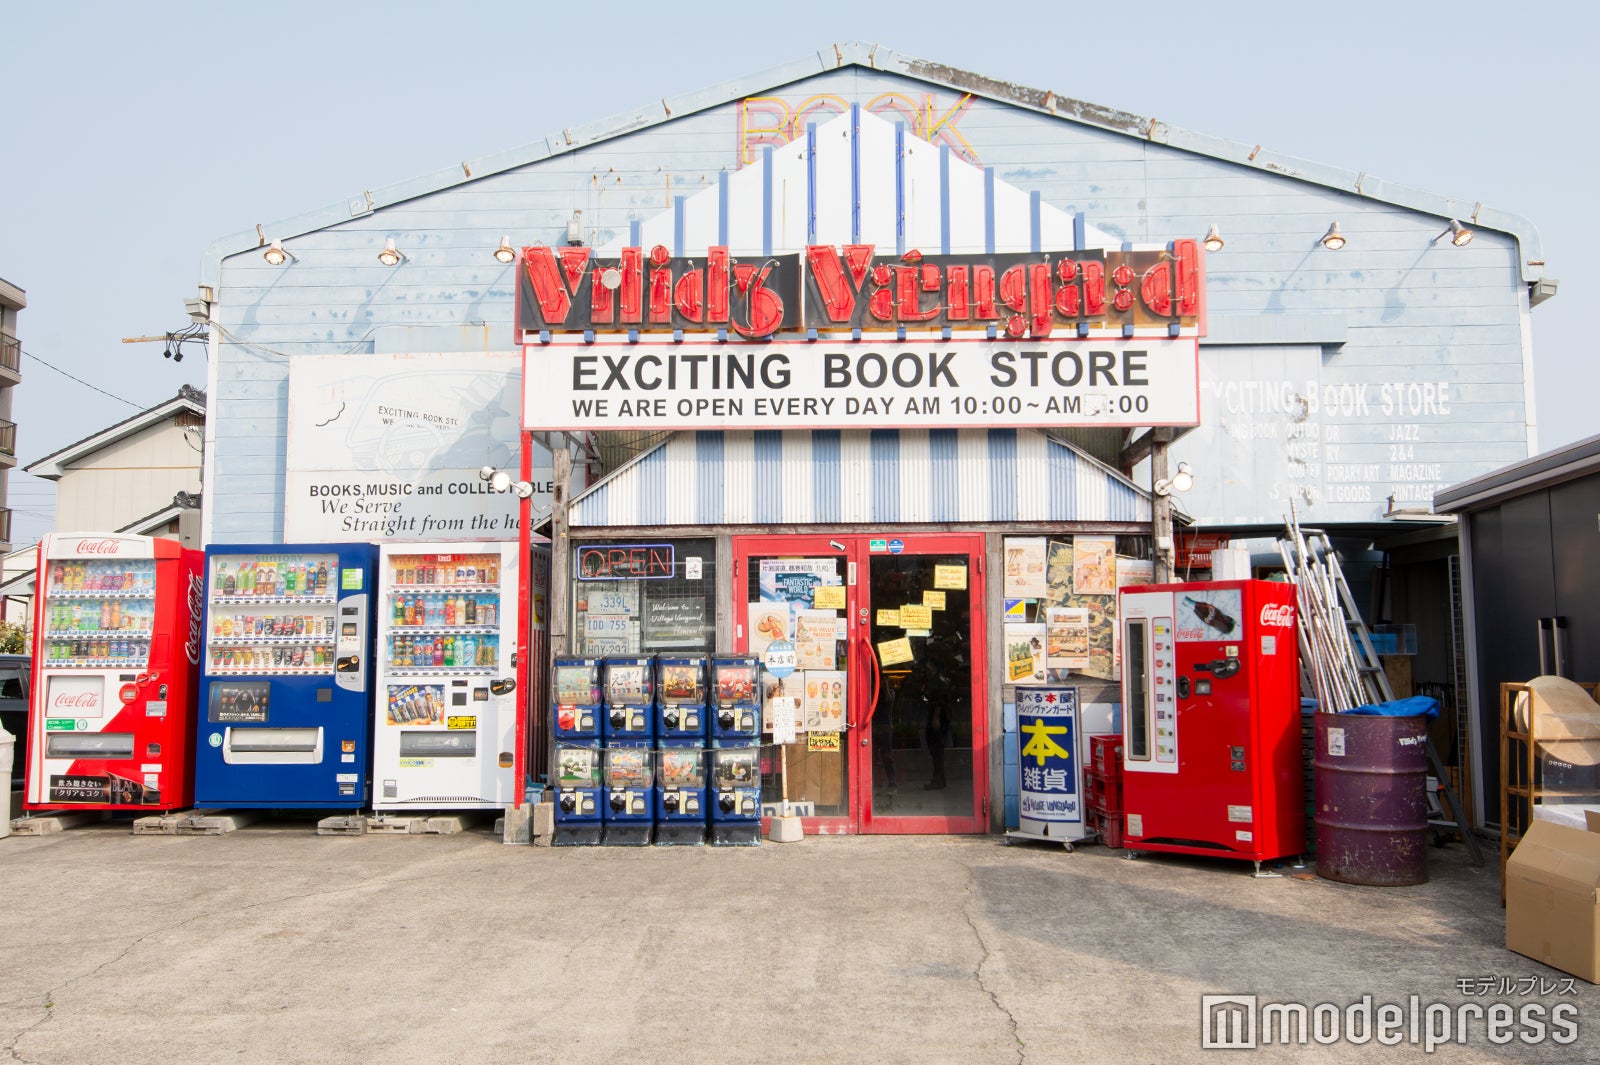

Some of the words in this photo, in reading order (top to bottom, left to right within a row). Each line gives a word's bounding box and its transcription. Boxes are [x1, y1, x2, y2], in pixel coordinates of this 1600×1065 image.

[573, 354, 791, 391] EXCITING
[824, 352, 960, 388] BOOK
[990, 350, 1149, 388] STORE
[572, 399, 609, 417] WE
[617, 398, 667, 417] ARE
[677, 398, 743, 416] OPEN
[754, 397, 836, 416] EVERY
[846, 397, 896, 416] DAY
[904, 397, 941, 415] AM
[1306, 379, 1370, 418] BOOK
[1381, 382, 1452, 418] STORE
[378, 405, 420, 419] EXCITING
[382, 418, 395, 426] WE
[1389, 424, 1420, 442] JAZZ
[1390, 463, 1442, 481] MAGAZINE
[417, 482, 443, 495] and
[1336, 484, 1372, 502] GOODS
[321, 499, 348, 514] We
[354, 498, 402, 514] Serve
[341, 514, 416, 536] Straight
[420, 514, 465, 538] from
[470, 513, 498, 530] the
[255, 554, 304, 563] SUNTORY
[582, 548, 670, 577] OPEN
[783, 578, 814, 586] FANTASTIC
[788, 585, 808, 594] WORLD
[651, 614, 674, 624] Village
[1020, 718, 1070, 766] 本
[1023, 766, 1068, 792] 雑貨
